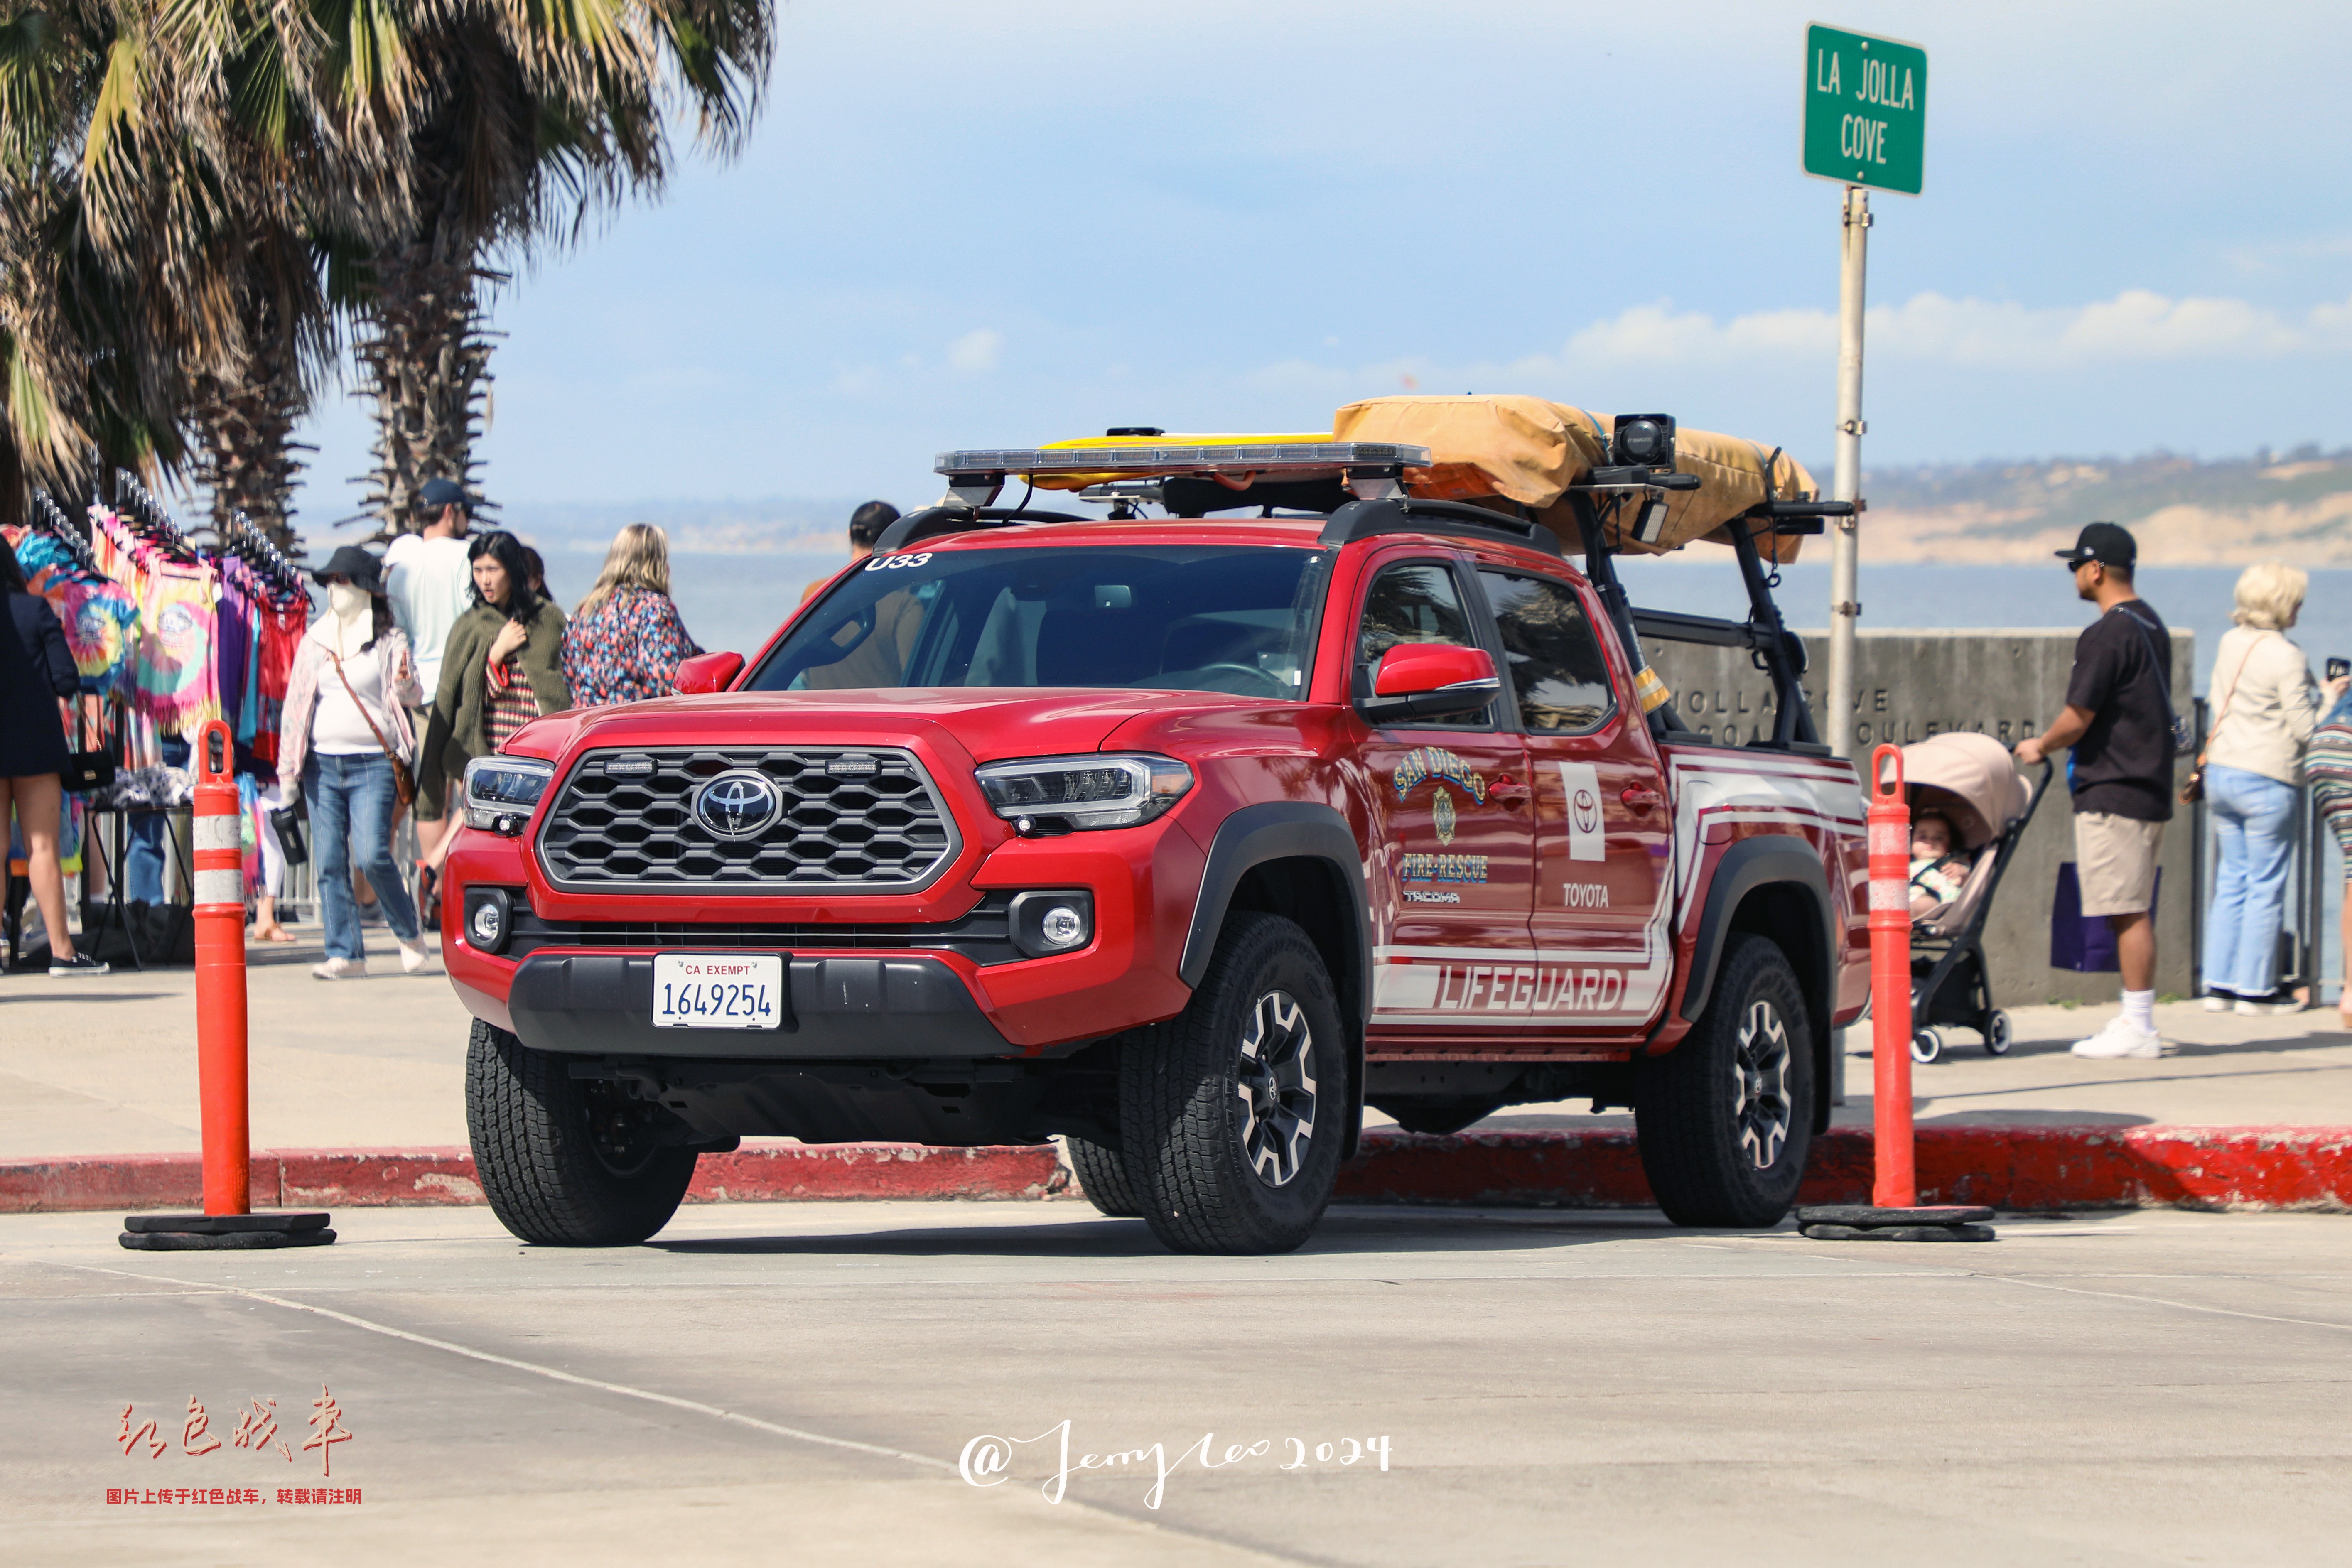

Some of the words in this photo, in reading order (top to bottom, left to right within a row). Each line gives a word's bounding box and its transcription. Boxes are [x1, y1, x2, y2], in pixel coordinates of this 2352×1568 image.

[1817, 49, 1841, 95] LA
[1856, 59, 1914, 110] JOLLA
[1841, 113, 1888, 164] COVE
[864, 552, 933, 571] U33
[1393, 748, 1428, 802] SAN
[1426, 746, 1486, 805] DIEGO
[1402, 853, 1488, 883] FIRE-RESCUE
[1403, 891, 1460, 903] TACOMA
[1564, 883, 1609, 908] TOYOTA
[685, 965, 700, 974] CA
[707, 966, 750, 975] EXEMPT
[662, 983, 771, 1016] 1649254
[1439, 966, 1622, 1011] LIFEGUARD
